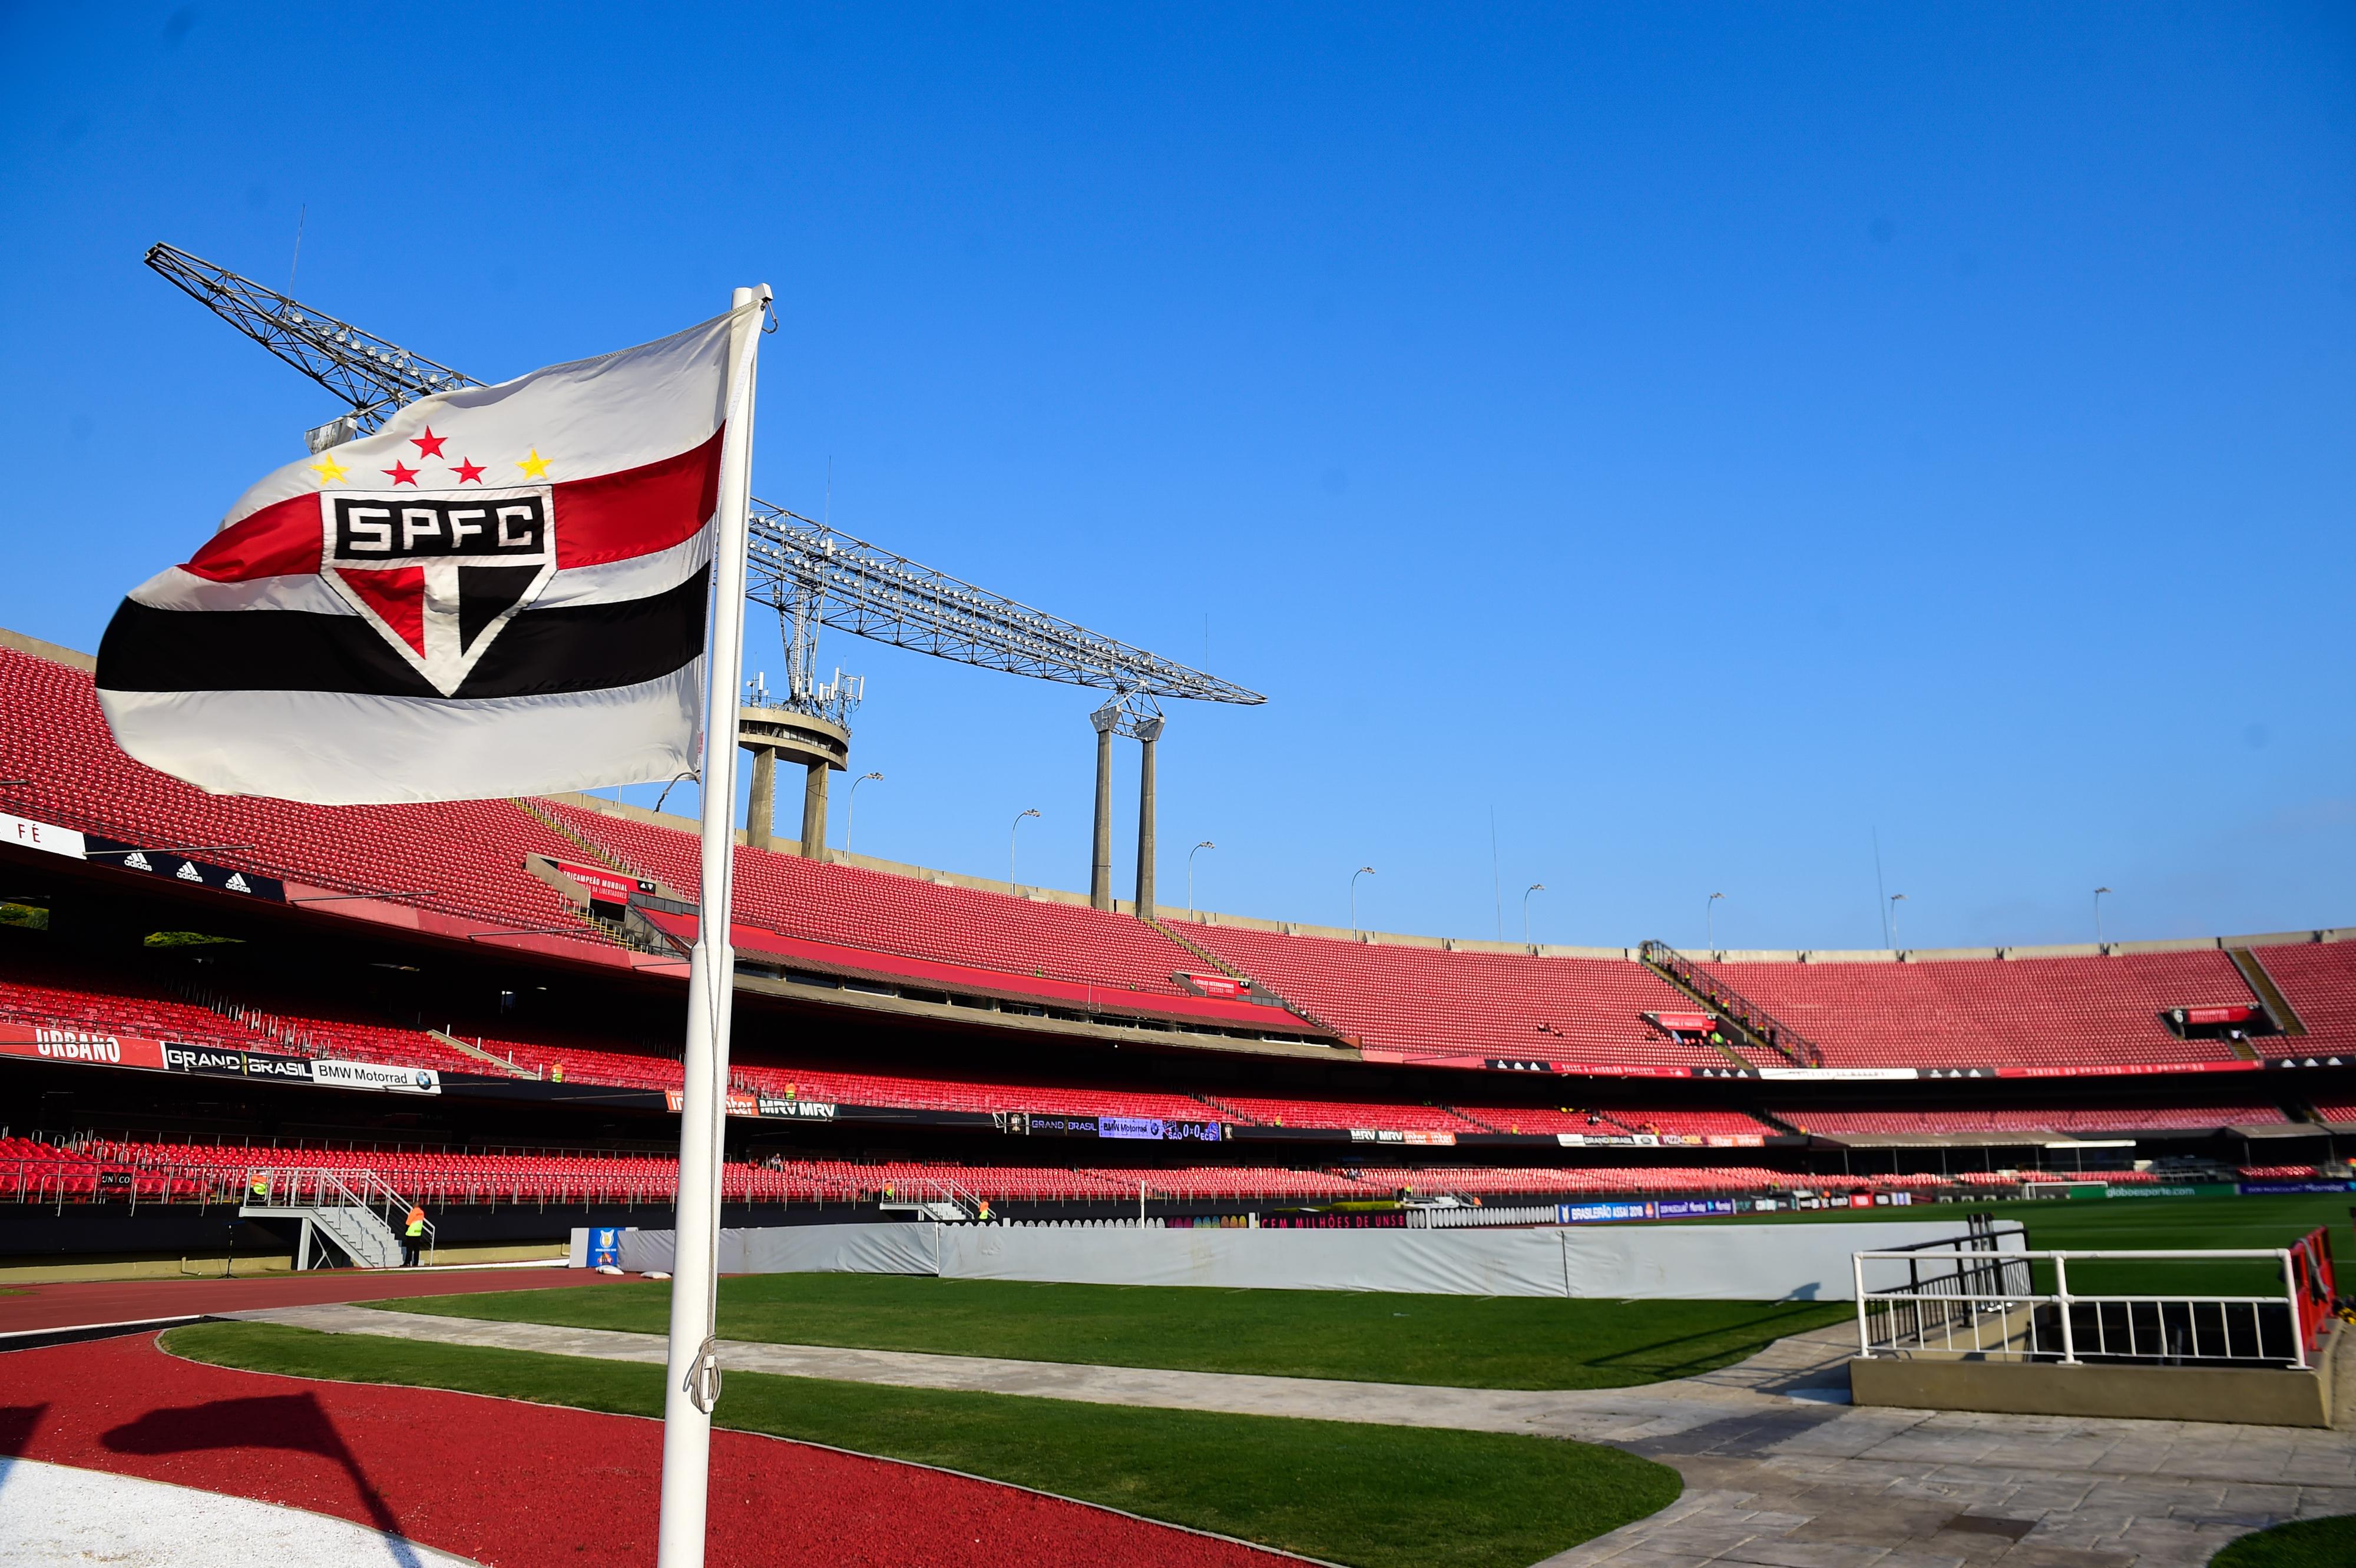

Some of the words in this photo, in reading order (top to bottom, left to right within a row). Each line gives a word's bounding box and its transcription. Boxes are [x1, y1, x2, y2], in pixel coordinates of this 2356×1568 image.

[348, 505, 534, 551] SPFC
[18, 823, 41, 843] FÉ
[124, 859, 153, 872] adidas
[176, 871, 203, 883] adidas
[225, 882, 252, 894] adidas
[601, 879, 628, 892] MUNDIAL
[598, 888, 627, 899] LIBERTADORES
[2174, 1009, 2183, 1023] 6
[35, 1028, 120, 1063] URBANO
[167, 1049, 241, 1070] GRAND
[249, 1059, 313, 1077] BRASIL
[319, 1065, 352, 1079] BMW
[355, 1068, 408, 1084] Motorrad
[759, 1099, 797, 1115] MRV
[799, 1102, 835, 1117] MRV
[1031, 1120, 1064, 1129] GRAND
[1068, 1122, 1097, 1131] BRASIL
[1103, 1123, 1119, 1131] BMW
[1120, 1123, 1147, 1132] Motorrad
[1183, 1123, 1189, 1137] 0
[1194, 1124, 1200, 1138] 0
[1200, 1132, 1214, 1141] ECB
[1351, 1130, 1376, 1140] MRV
[1378, 1130, 1403, 1140] MRV
[1295, 1214, 1349, 1229] MILHÕES
[1356, 1215, 1369, 1228] DE
[1375, 1215, 1396, 1227] UNS
